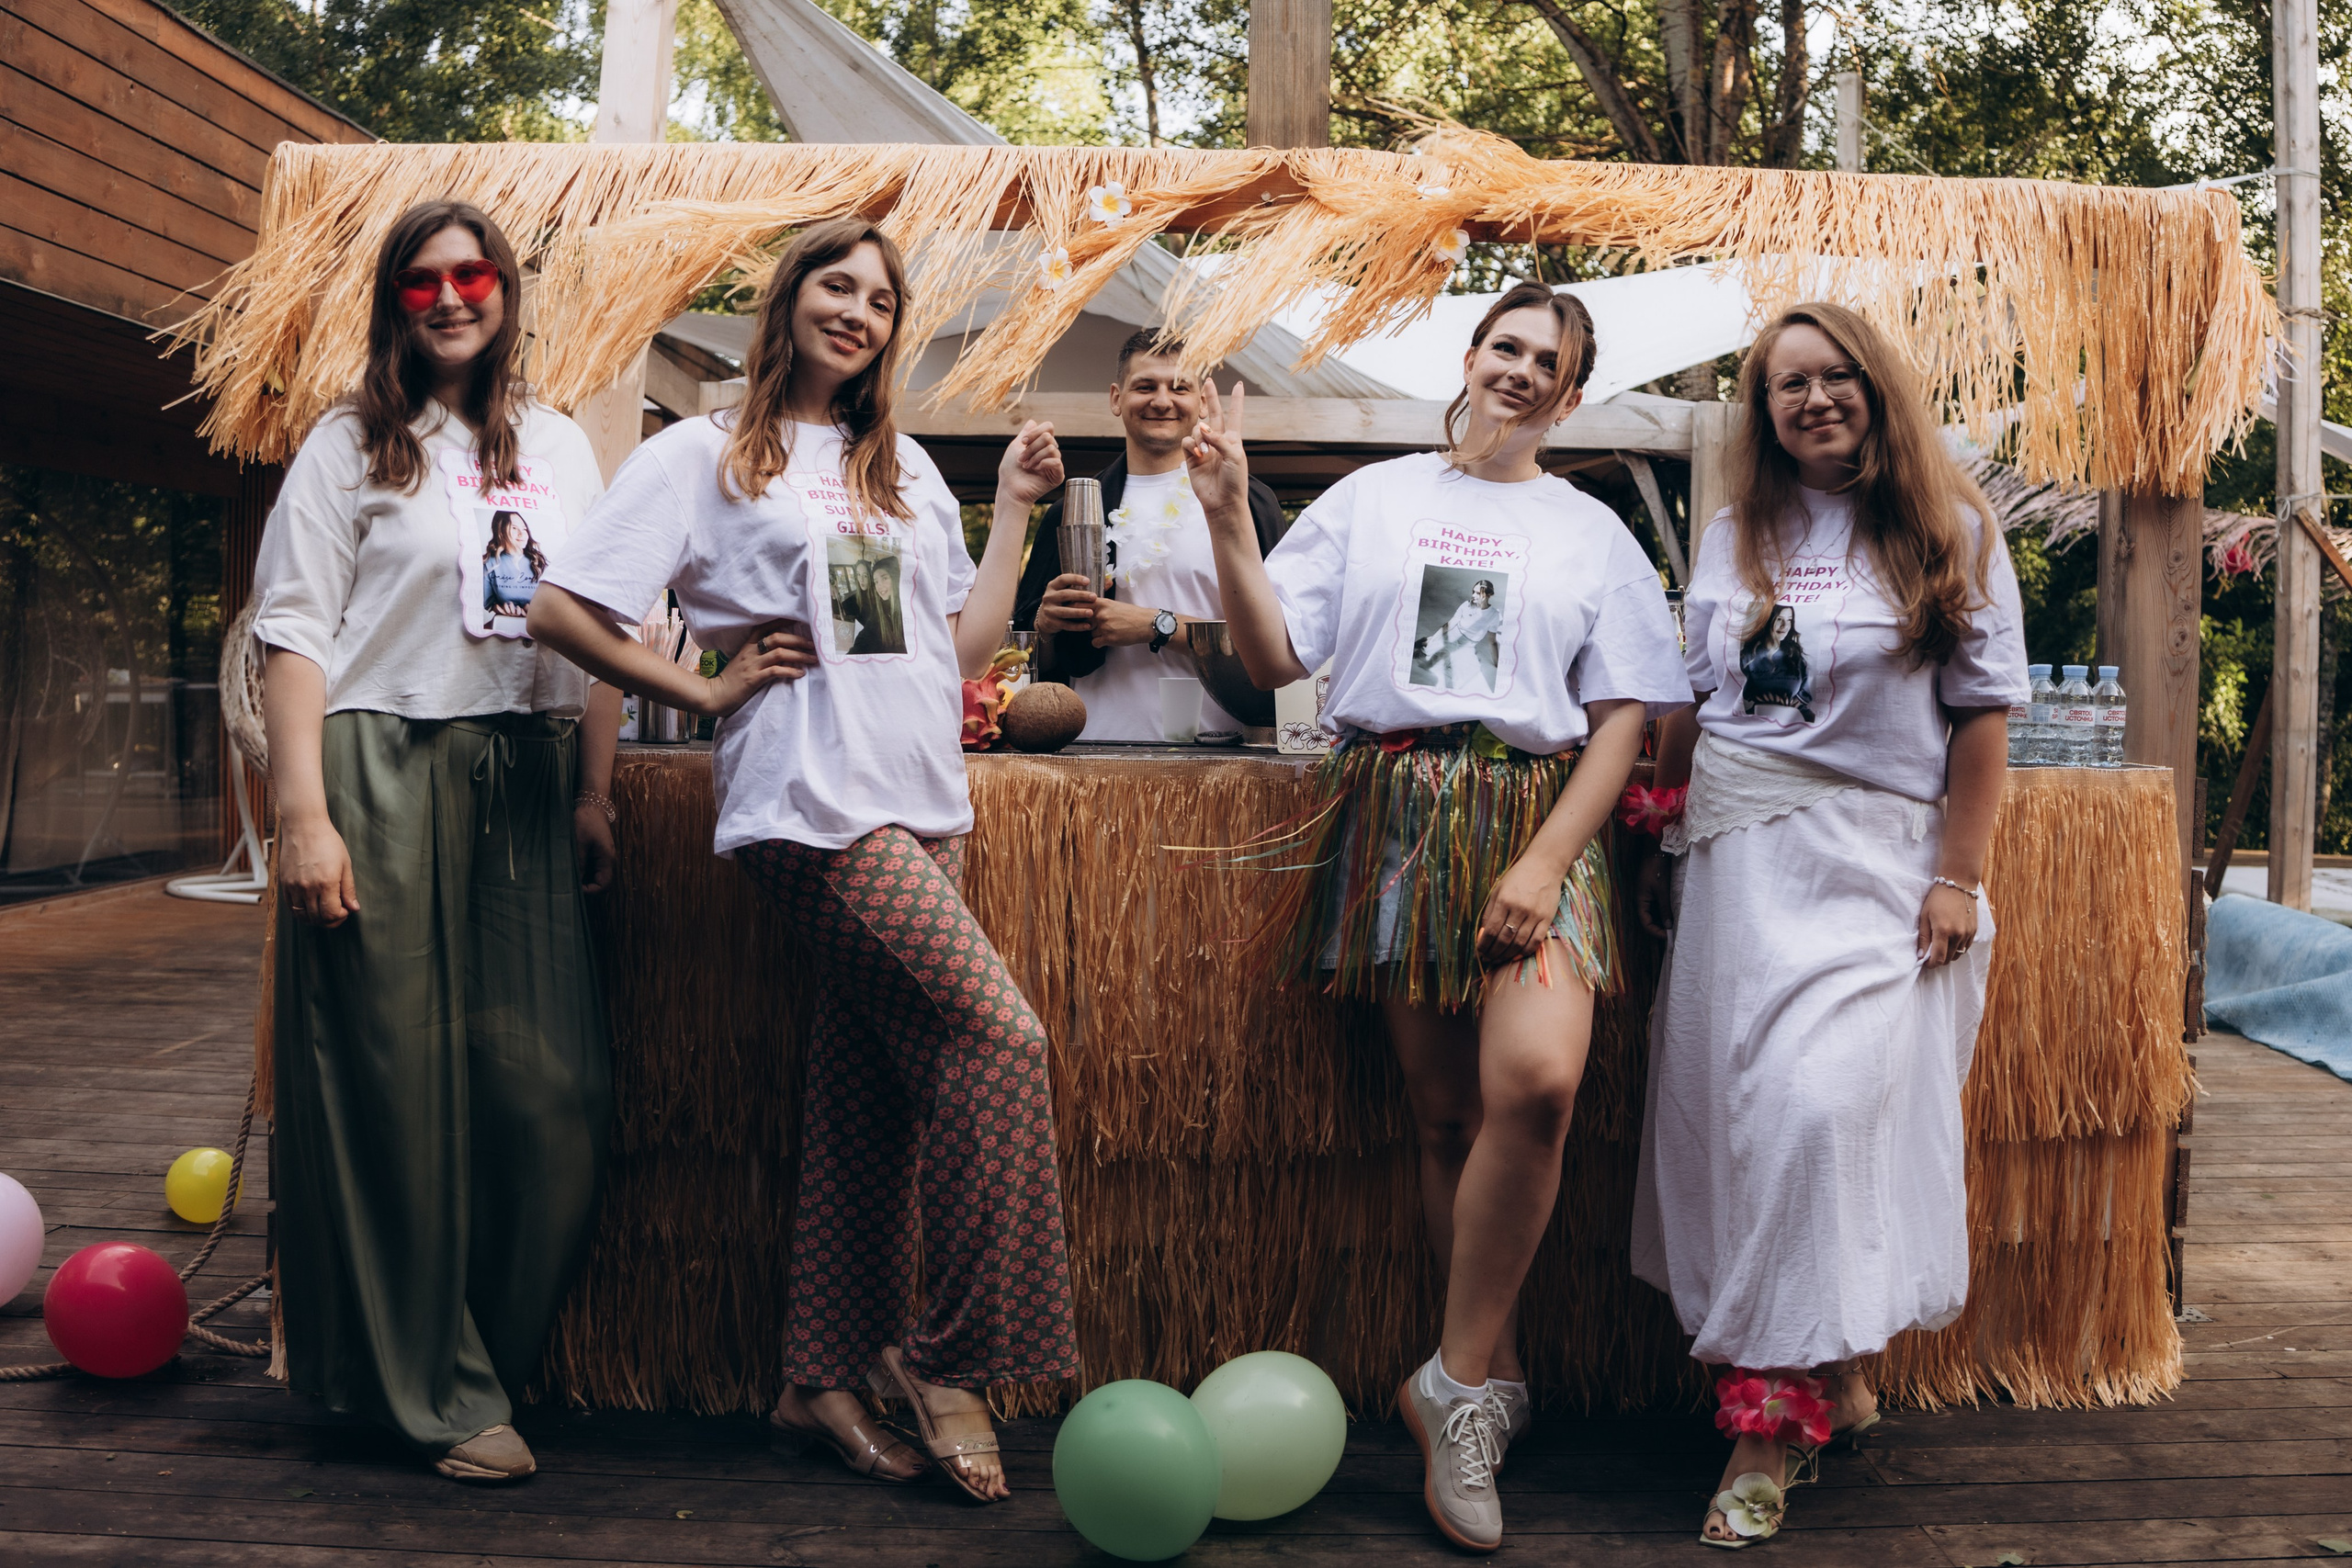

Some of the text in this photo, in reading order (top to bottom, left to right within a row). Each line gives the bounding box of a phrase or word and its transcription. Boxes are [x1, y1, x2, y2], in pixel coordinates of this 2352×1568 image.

[457, 475, 555, 500] BIHDAY,
[487, 494, 539, 510] KATE!
[837, 521, 890, 536] GILS!
[1441, 527, 1503, 547] HAPPY
[1418, 538, 1521, 559] BIRTHDAY,
[1440, 555, 1494, 568] KATE!
[1778, 566, 1839, 578] HAPPY
[1774, 594, 1821, 604] ATE!
